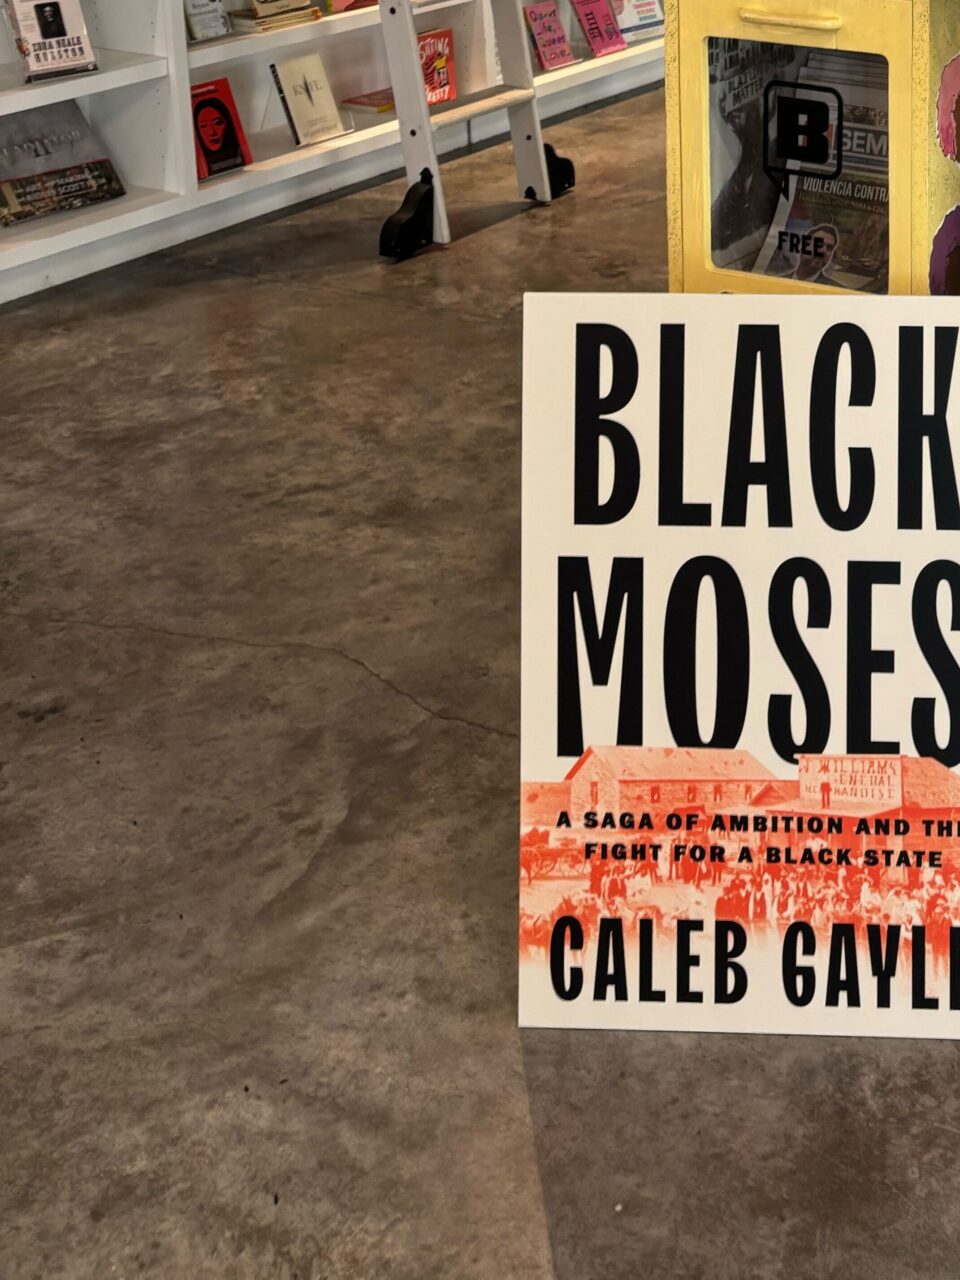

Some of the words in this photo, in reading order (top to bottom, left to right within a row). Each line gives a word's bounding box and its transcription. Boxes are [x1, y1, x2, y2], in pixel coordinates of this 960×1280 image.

[803, 176, 851, 196] VIOLENCIA
[778, 231, 825, 257] FREE
[556, 811, 571, 829] A
[583, 812, 654, 829] SAGA
[666, 814, 699, 831] OF
[711, 814, 843, 834] AMBITION
[856, 818, 910, 836] AND
[584, 843, 661, 861] FIGHT
[674, 845, 725, 862] FOR
[738, 846, 753, 863] A
[766, 847, 853, 866] BLACK
[864, 849, 942, 868] STATE
[550, 916, 748, 1005] CALEB
